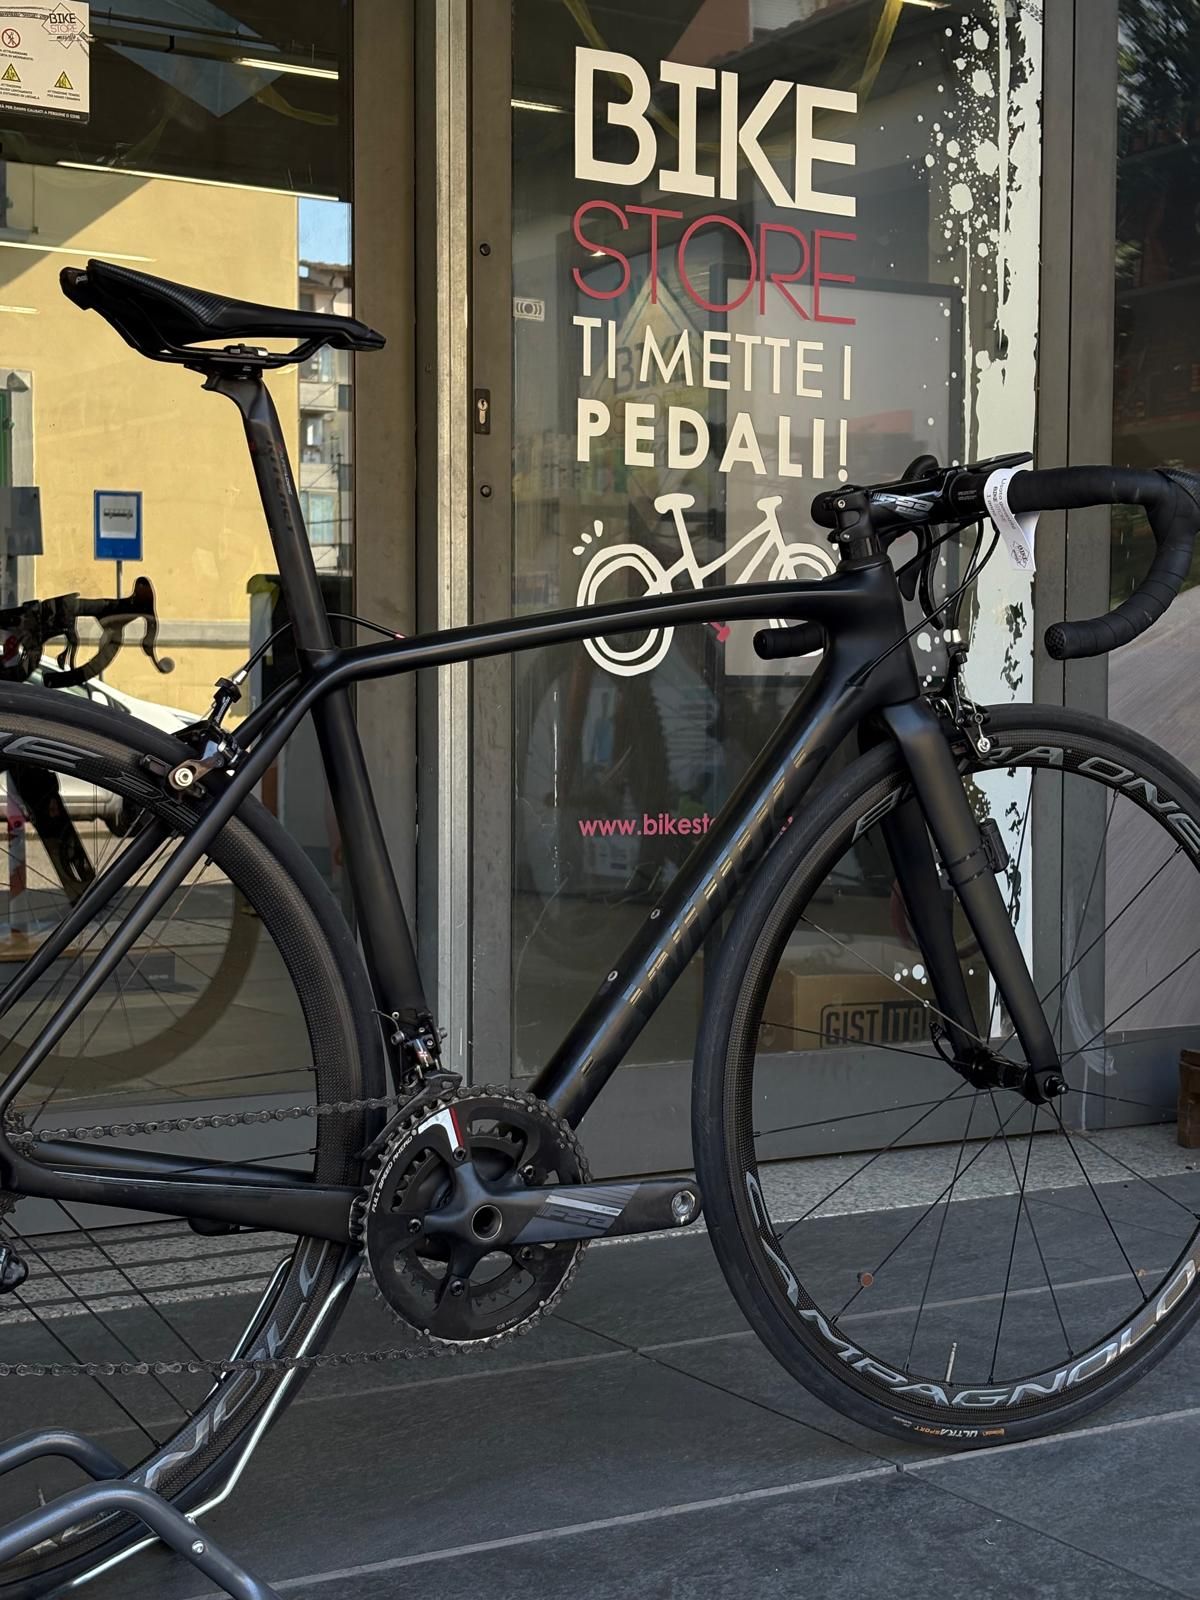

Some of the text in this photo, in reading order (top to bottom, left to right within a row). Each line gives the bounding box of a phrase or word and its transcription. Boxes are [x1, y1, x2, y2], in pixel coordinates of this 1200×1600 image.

[49, 13, 76, 24] BIKE
[50, 24, 78, 33] STORE
[575, 46, 857, 217] BIKE
[572, 200, 857, 325] STORE
[572, 316, 852, 401] TI METTE I
[576, 398, 849, 482] PEDALI!
[826, 1010, 879, 1045] GIST
[371, 1136, 413, 1213] FULL SPEED AHEAD
[745, 1171, 1199, 1409] CAMPAGNOLO
